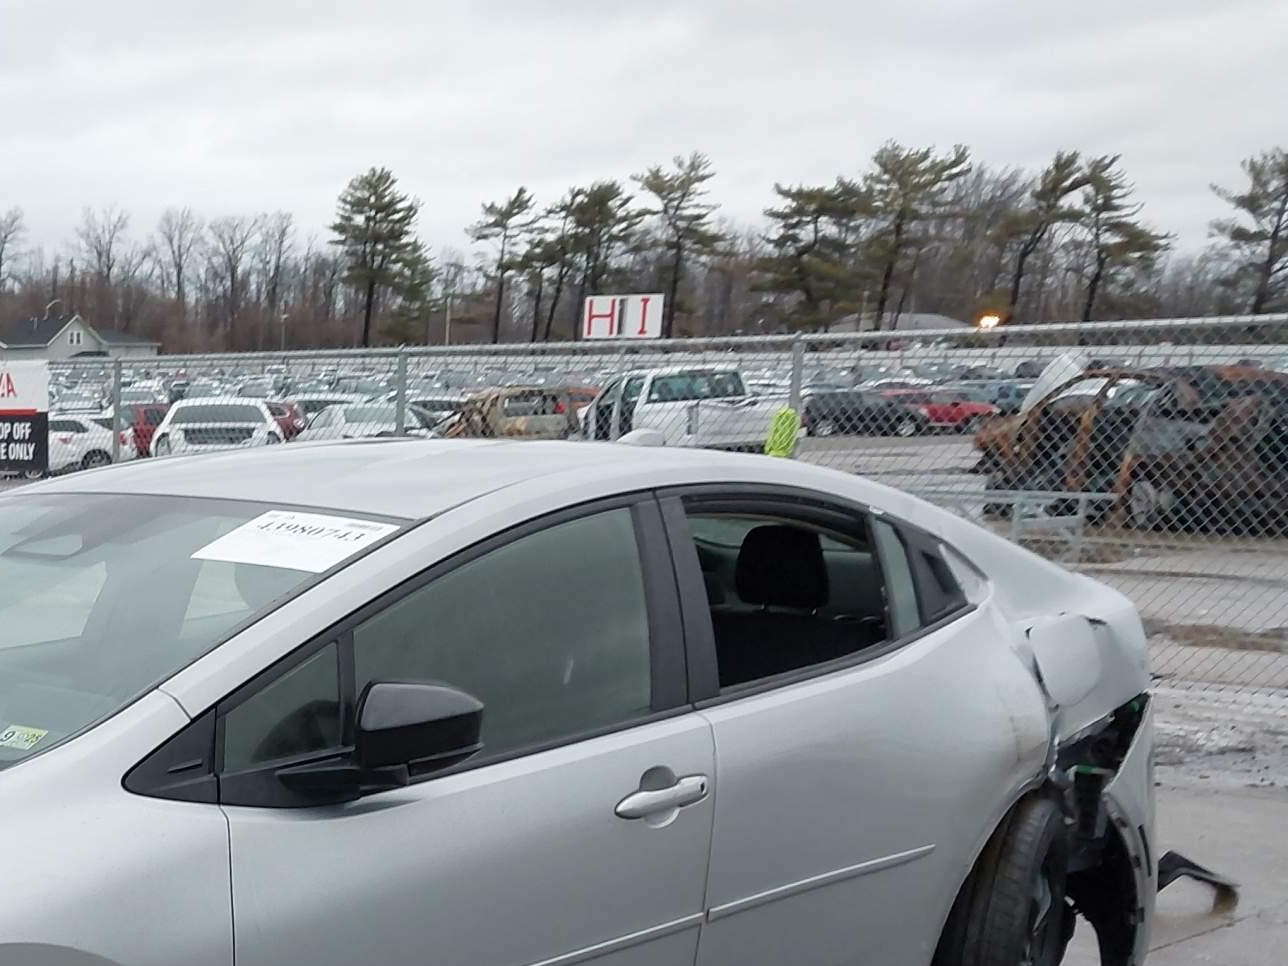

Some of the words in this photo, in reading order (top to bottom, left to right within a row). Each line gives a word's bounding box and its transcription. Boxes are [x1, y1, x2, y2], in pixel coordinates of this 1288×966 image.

[12, 422, 32, 440] OFF
[8, 442, 36, 460] ONLY
[0, 730, 16, 743] 9
